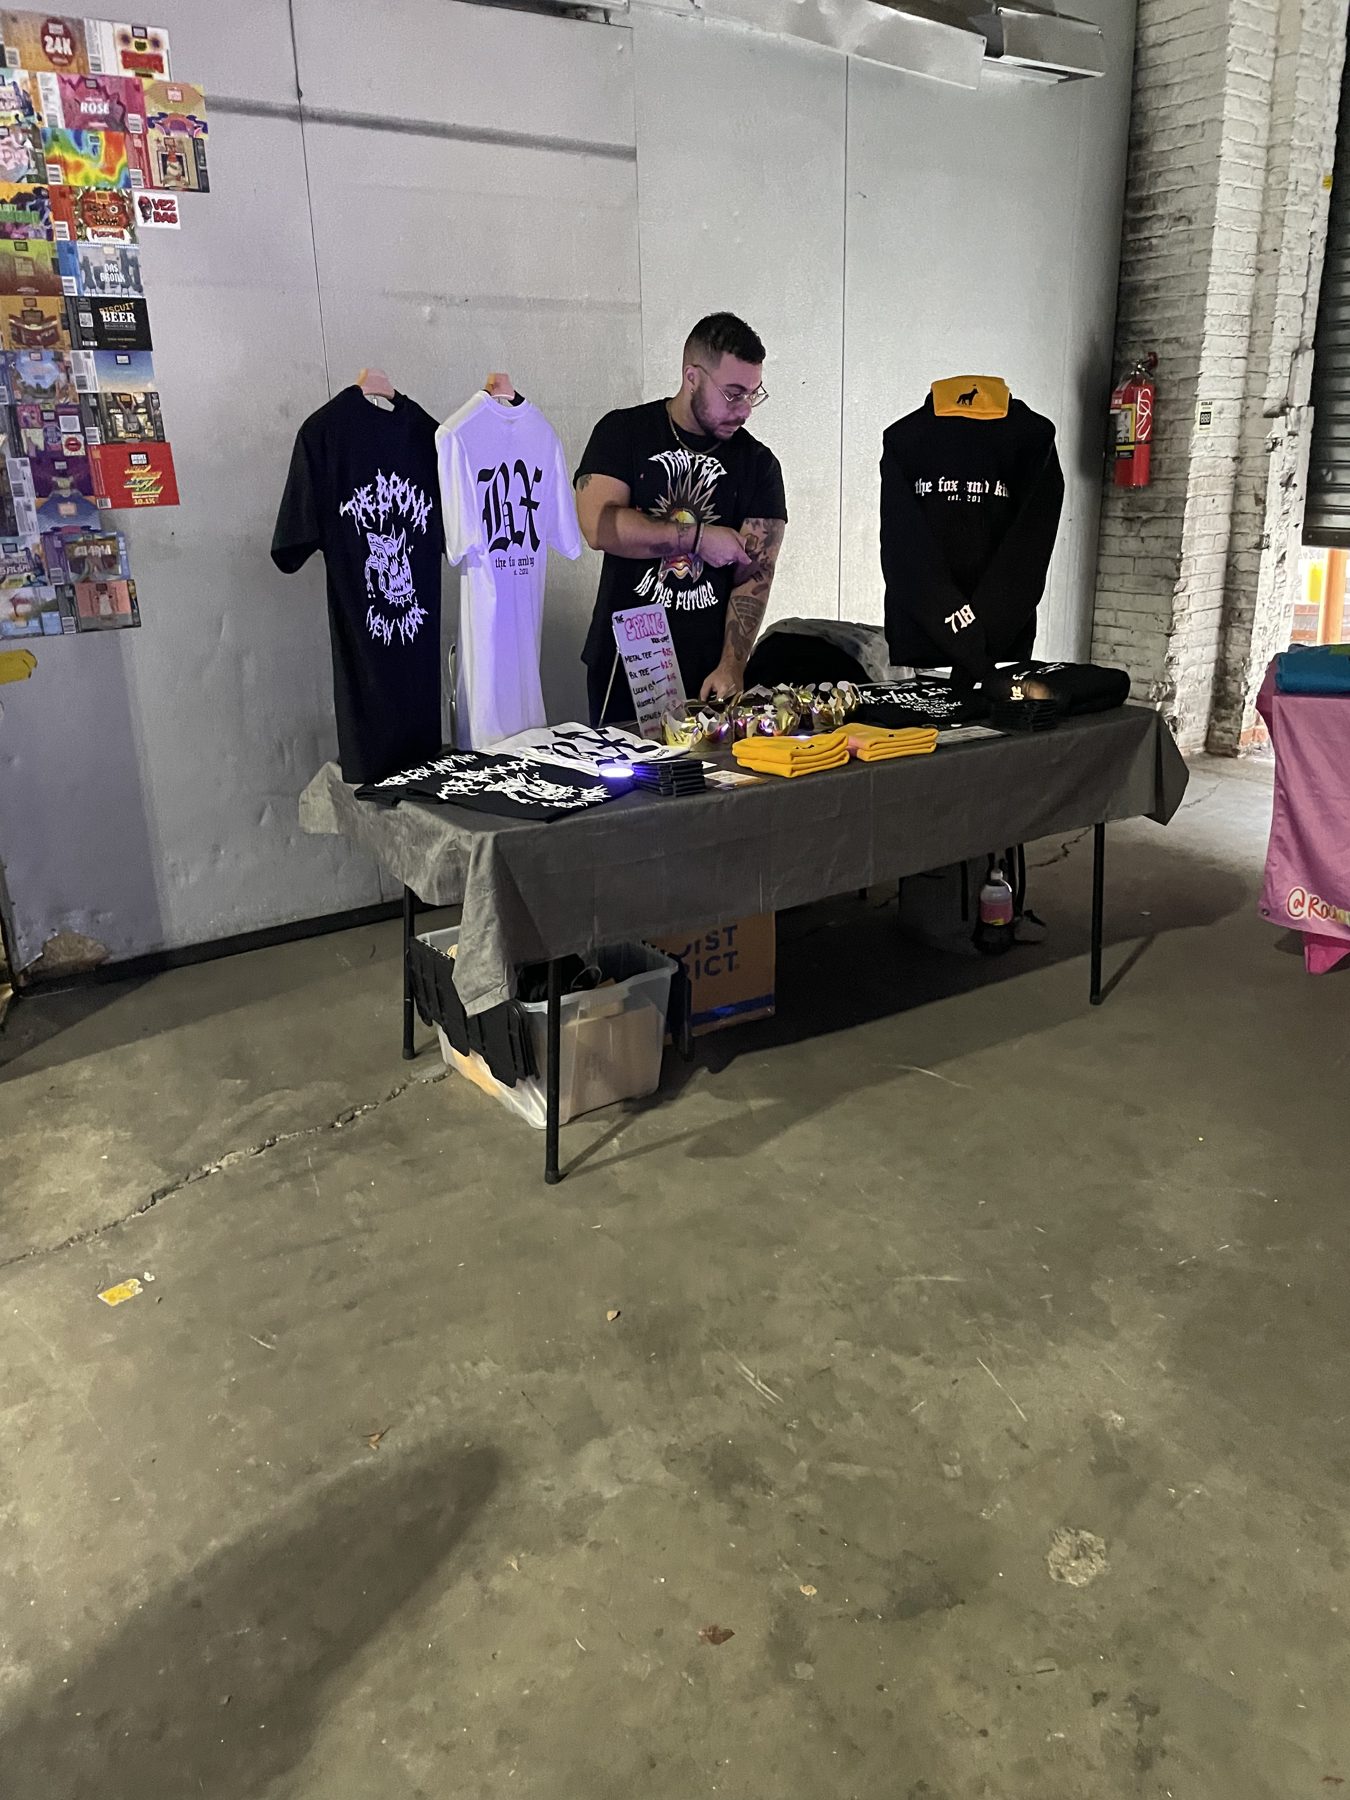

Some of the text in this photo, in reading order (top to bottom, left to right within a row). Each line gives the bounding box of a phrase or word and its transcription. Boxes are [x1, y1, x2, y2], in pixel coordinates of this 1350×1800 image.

[99, 302, 135, 315] BISCUIT
[101, 311, 137, 323] BEER
[914, 478, 933, 497] the
[938, 476, 959, 493] fox
[632, 566, 656, 597] IN
[675, 579, 719, 611] FUTURE
[624, 611, 666, 642] SPRING
[944, 603, 976, 634] 718
[641, 650, 653, 660] TEE
[683, 951, 738, 980] ICT
